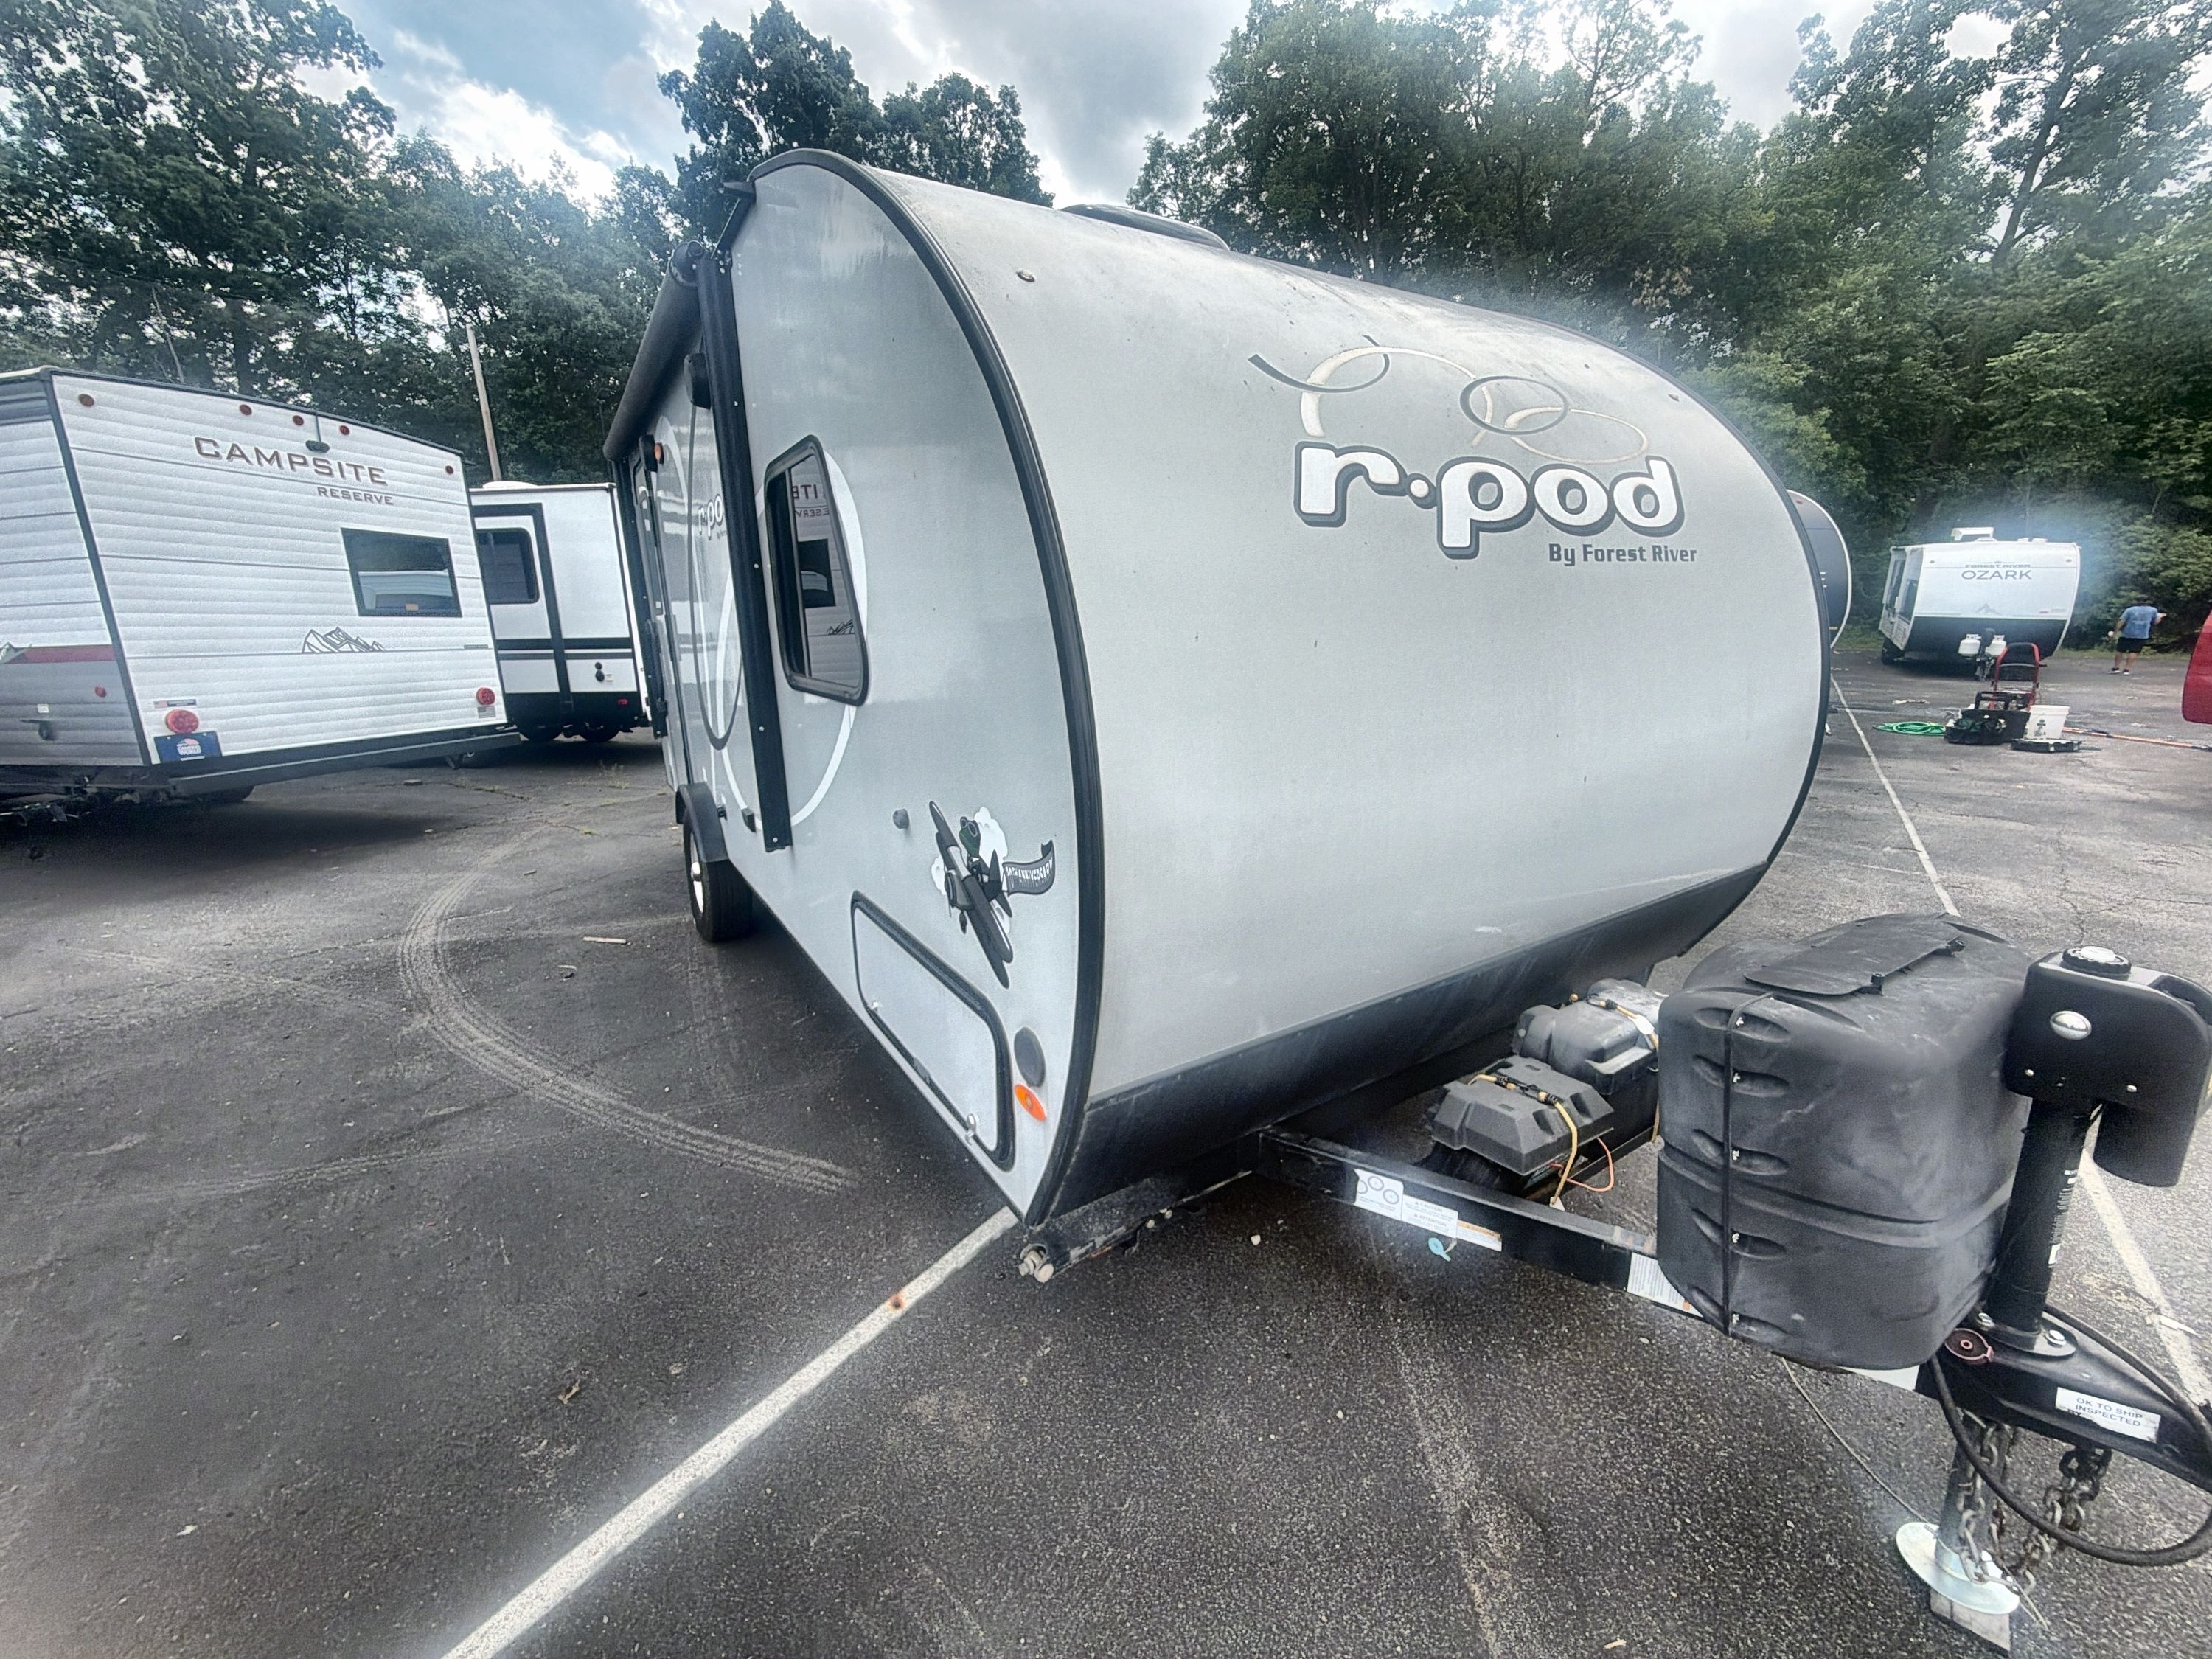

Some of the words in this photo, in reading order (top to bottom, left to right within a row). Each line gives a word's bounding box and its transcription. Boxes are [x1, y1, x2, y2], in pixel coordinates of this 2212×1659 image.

[195, 437, 388, 486] CAMPSITE
[317, 486, 394, 506] RESERVE
[1548, 543, 1576, 566] By
[1582, 544, 1646, 562] Forest
[1652, 545, 1697, 562] River
[1961, 570, 2032, 580] OZARK
[2076, 1397, 2093, 1406] OK
[2096, 1402, 2112, 1412] TO
[2115, 1408, 2143, 1419] SHIP
[2076, 1404, 2141, 1427] INSPECTED
